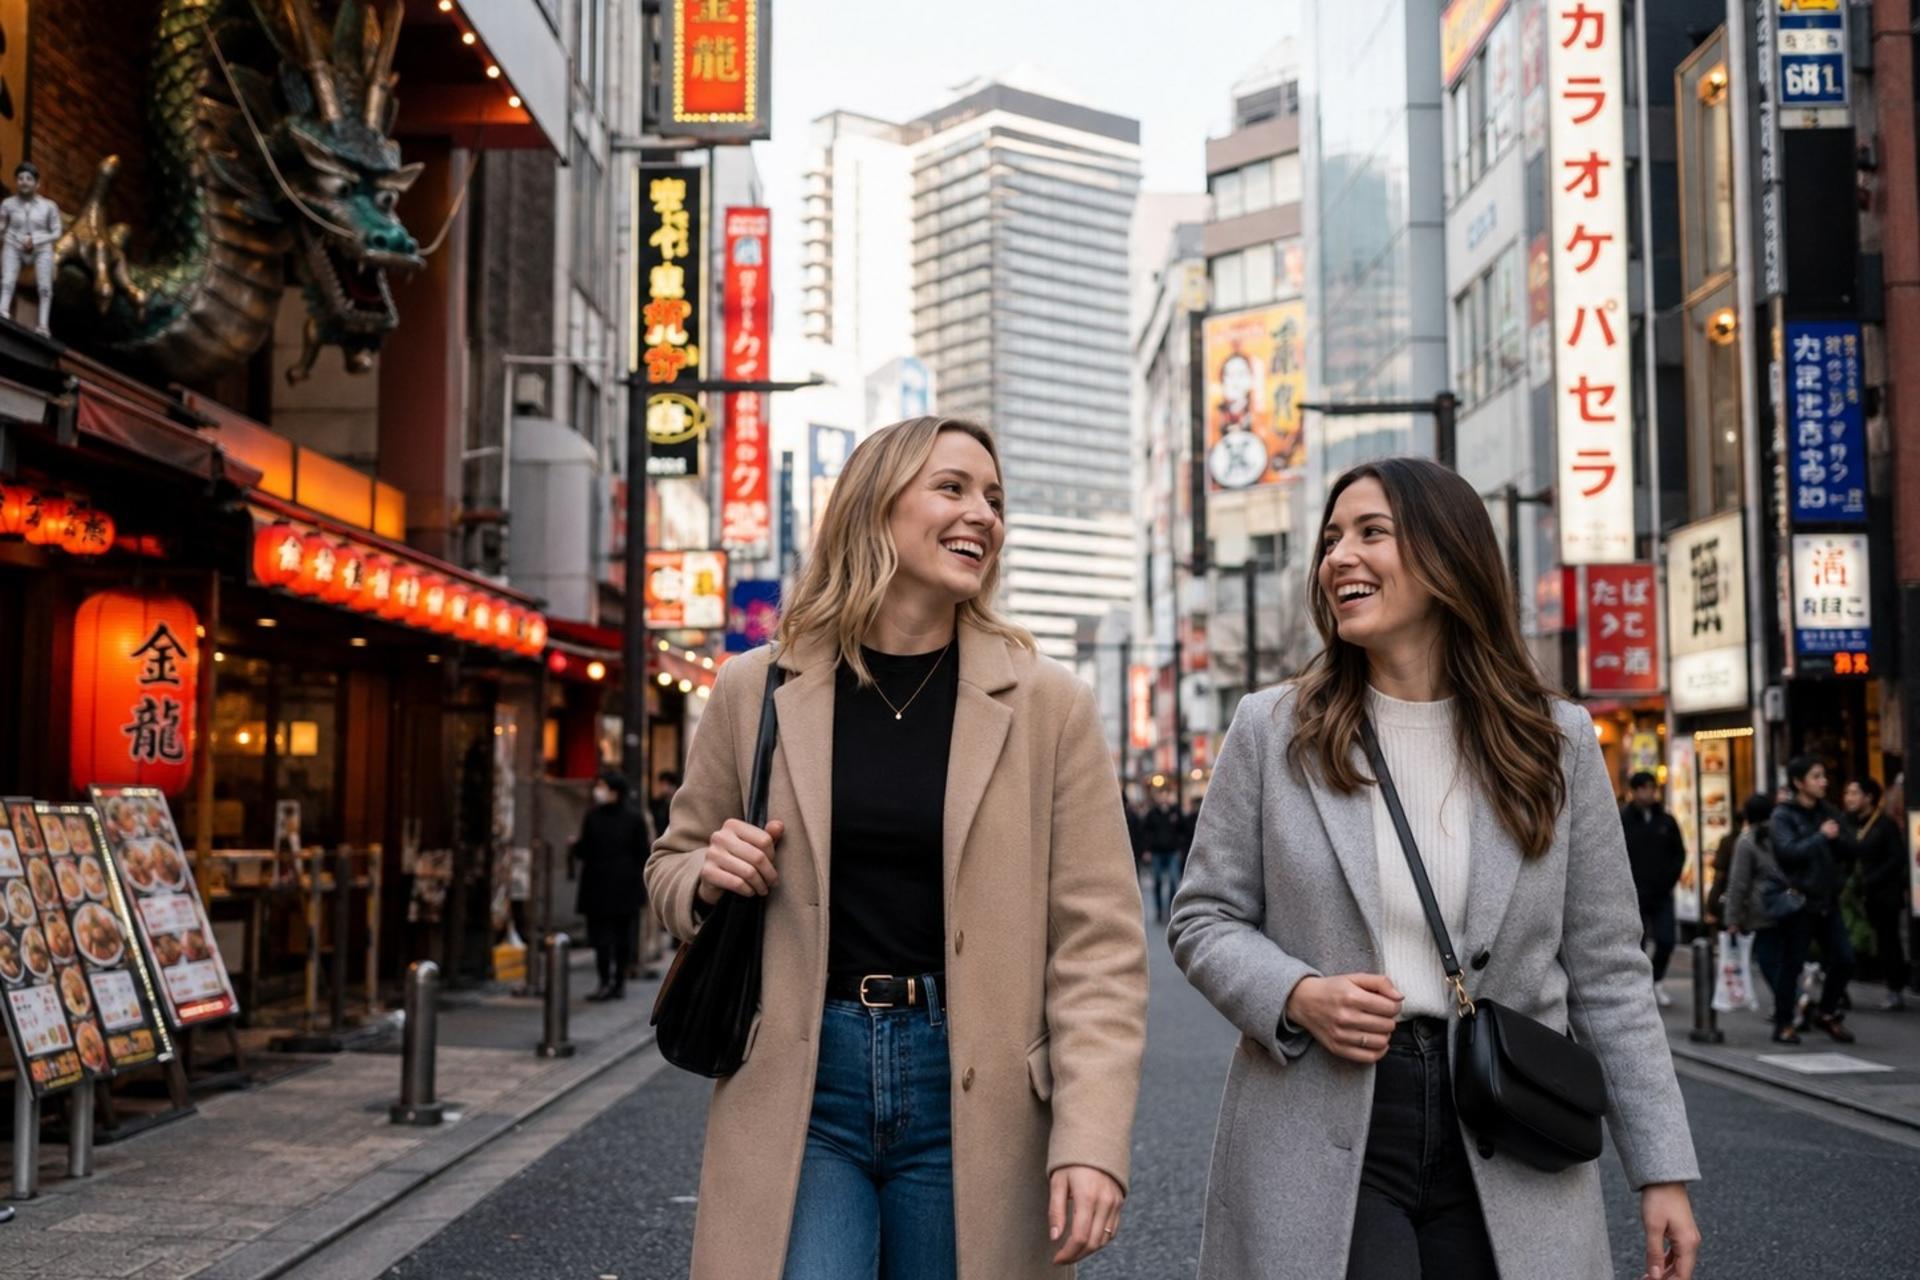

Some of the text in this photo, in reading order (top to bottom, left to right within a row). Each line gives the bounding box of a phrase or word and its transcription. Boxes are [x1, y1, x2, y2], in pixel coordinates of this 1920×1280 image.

[1561, 3, 1617, 497] カラオケパセラ
[124, 622, 188, 763] 金龍
